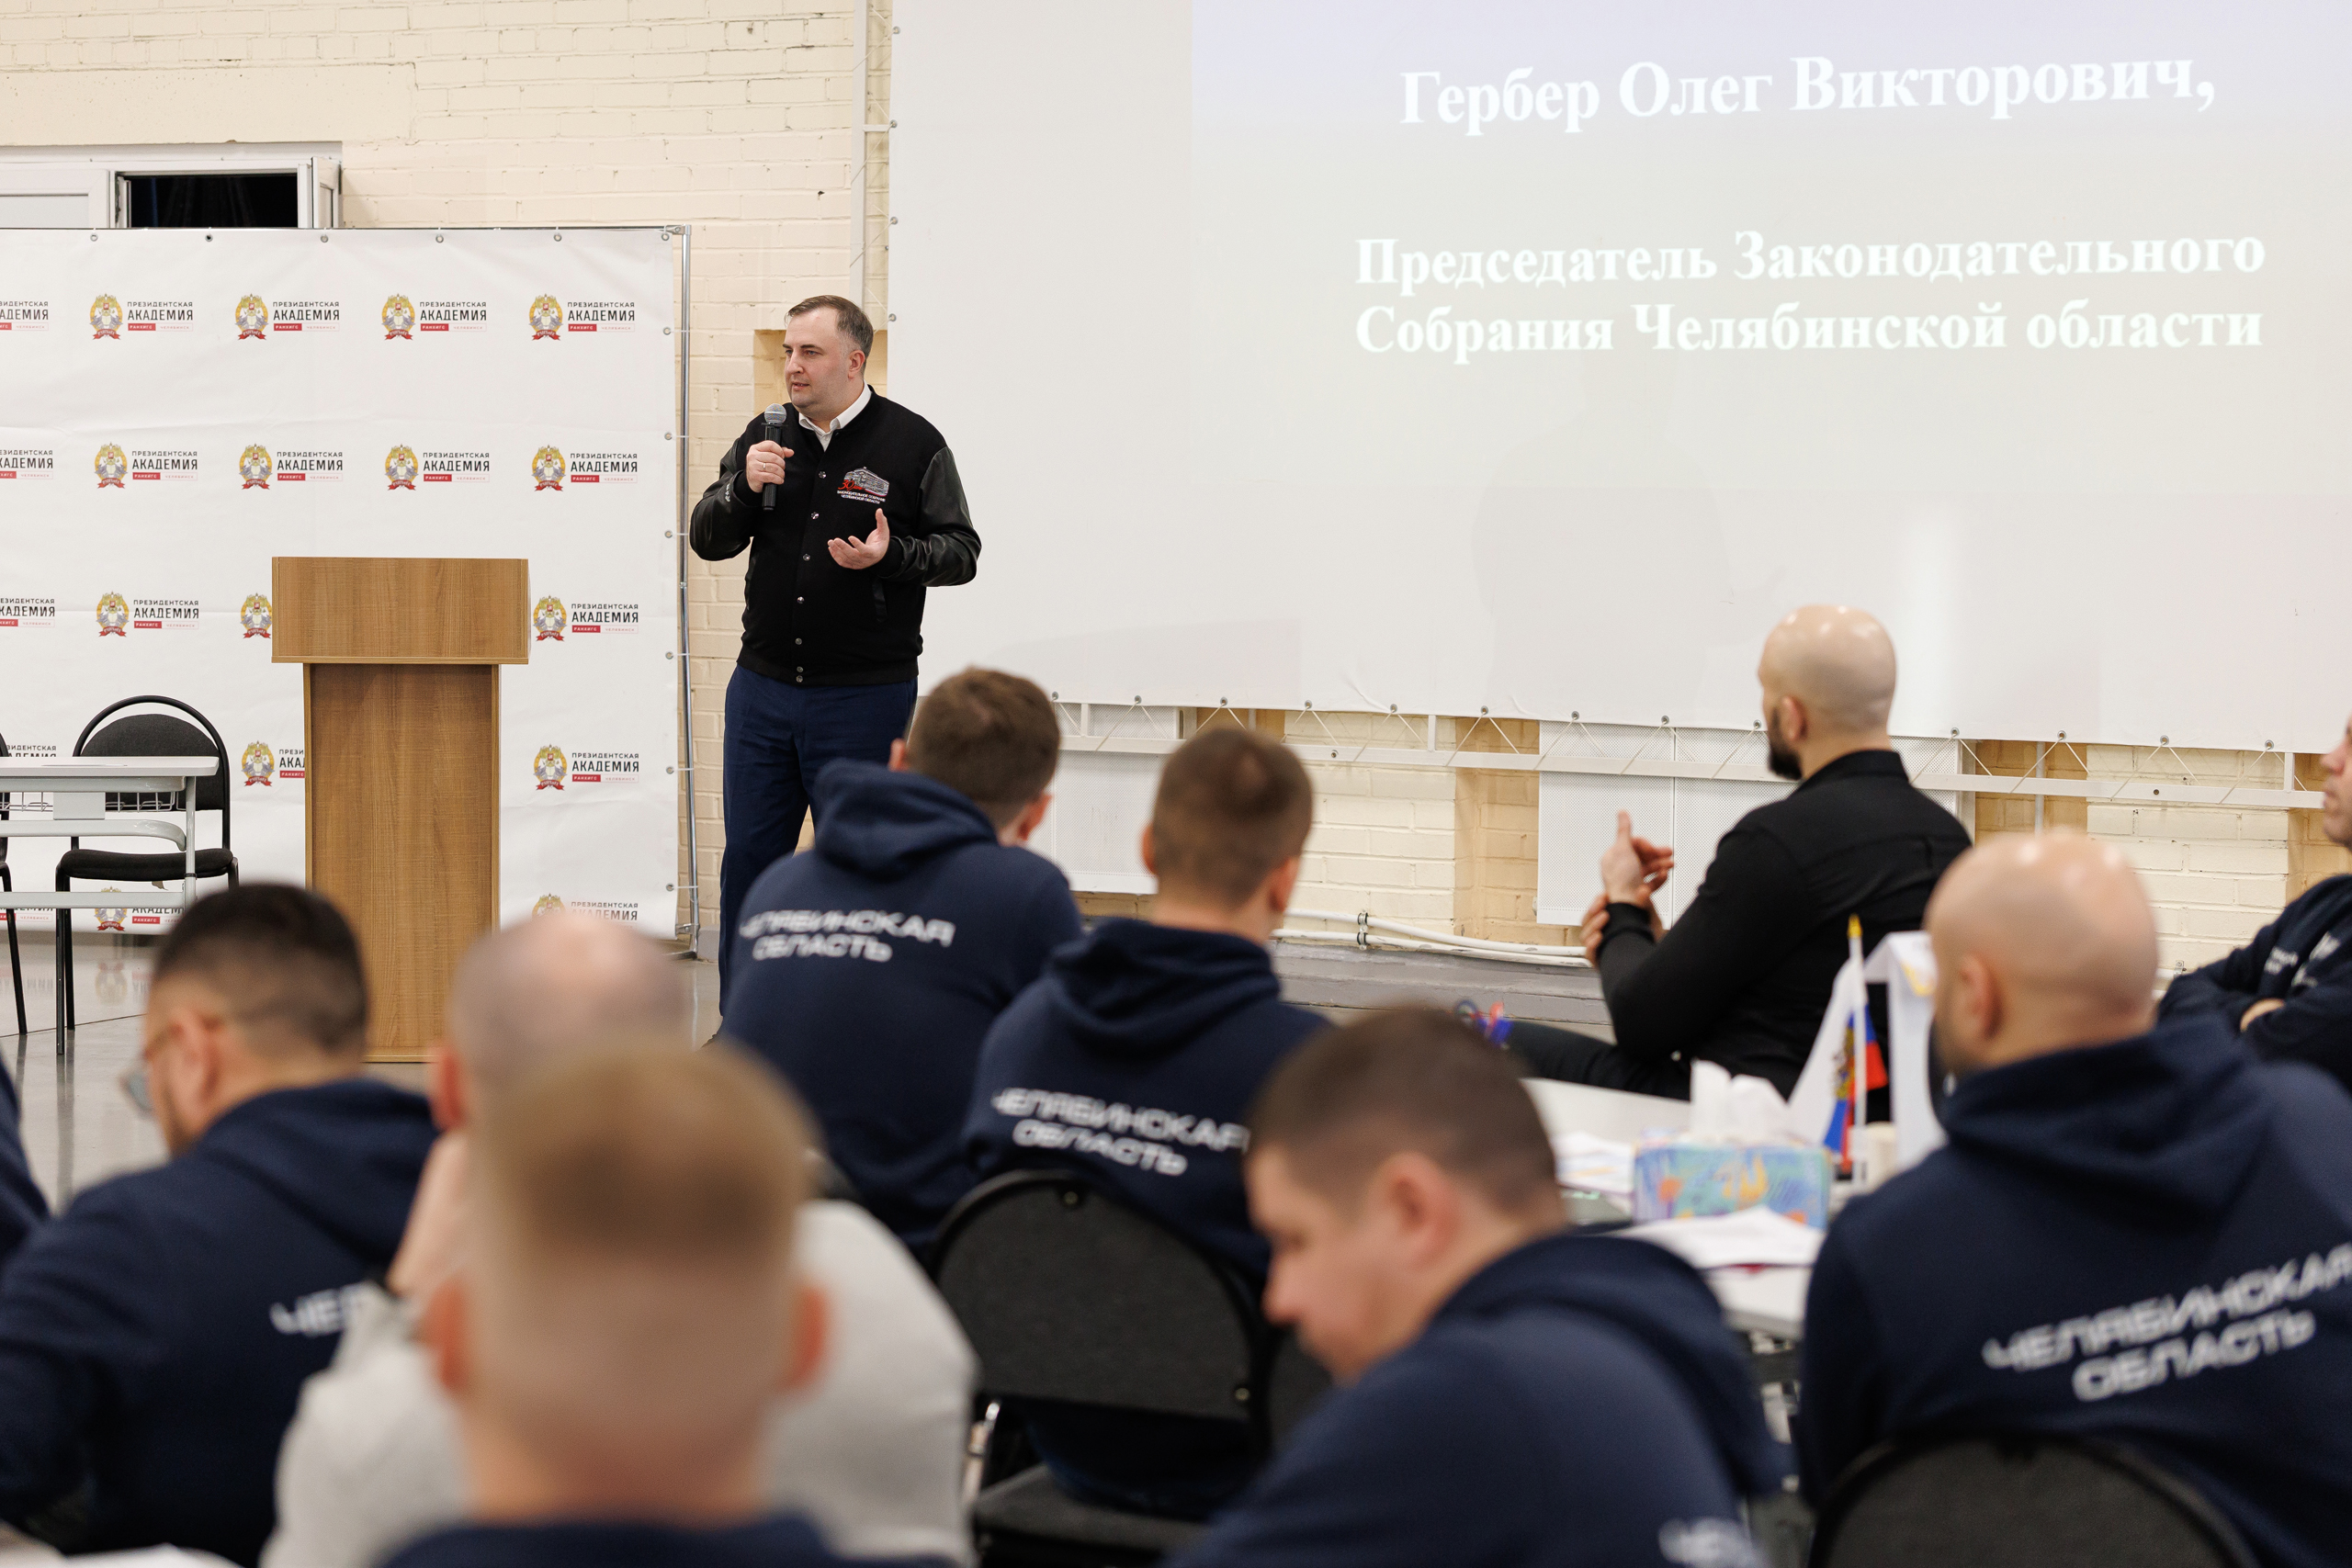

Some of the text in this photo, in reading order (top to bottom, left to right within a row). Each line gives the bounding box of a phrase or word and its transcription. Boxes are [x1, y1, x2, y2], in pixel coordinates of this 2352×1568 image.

[1400, 55, 2215, 136] Гербер Олег Викторович,
[1355, 230, 2267, 297] Председатель Законодательного
[0, 310, 49, 320] АДЕМИЯ
[128, 310, 193, 321] АКАДЕМИЯ
[273, 310, 339, 321] АКАДЕМИЯ
[420, 310, 486, 321] АКАДЕМИЯ
[568, 310, 635, 321] АКАДЕМИЯ
[1355, 298, 2264, 365] Собрания Челябинской области
[0, 457, 52, 468] КАДЕМИЯ
[132, 458, 198, 469] АКАДЕМИЯ
[277, 459, 343, 470] АКАДЕМИЯ
[424, 460, 489, 471] АКАДЕМИЯ
[571, 461, 638, 472] АКАДЕМИЯ
[0, 606, 55, 616] КАДЕМИЯ
[133, 607, 198, 618] АКАДЕМИЯ
[571, 612, 639, 623] АКАДЕМИЯ
[572, 761, 639, 772] АКАДЕМИЯ
[1012, 1118, 1188, 1177] ОБЛАСТЬ
[2071, 1309, 2316, 1402] ОБЛАСТЬ
